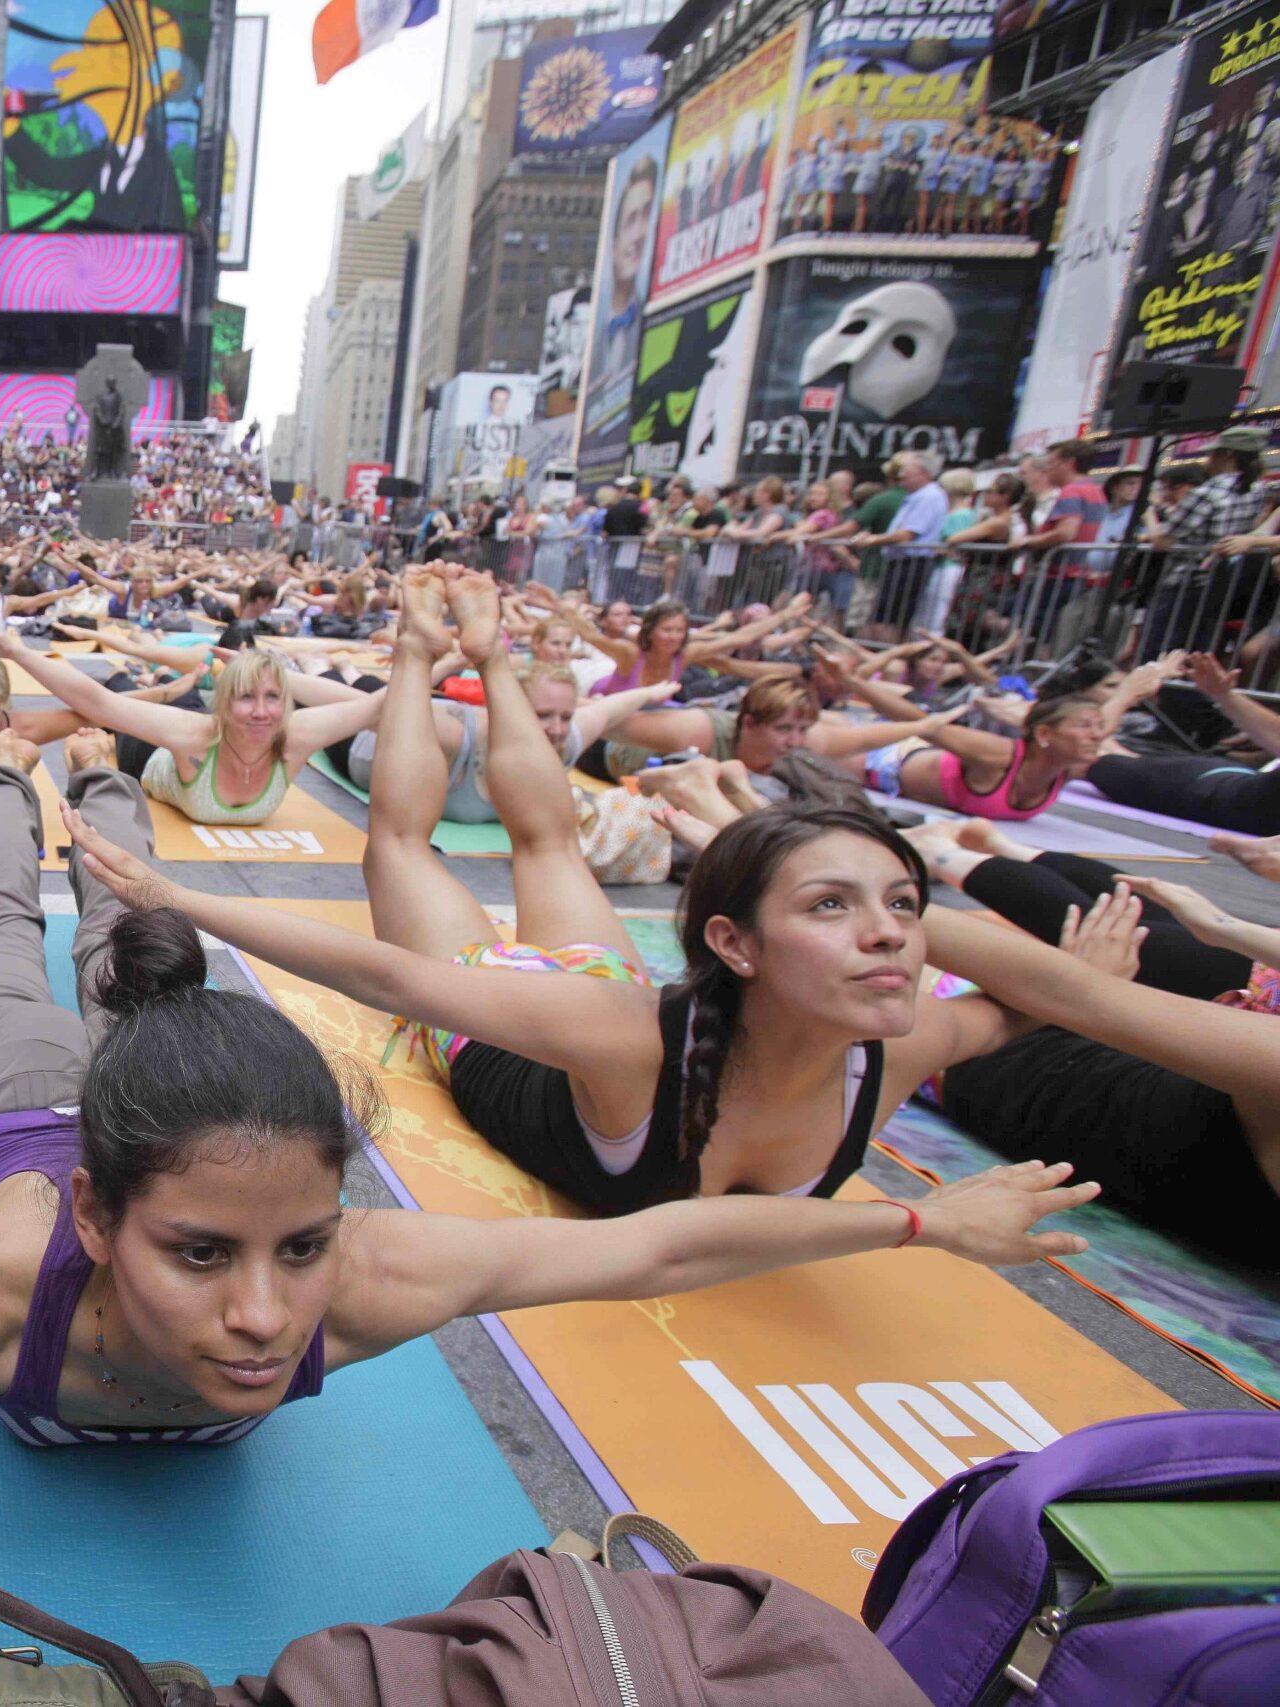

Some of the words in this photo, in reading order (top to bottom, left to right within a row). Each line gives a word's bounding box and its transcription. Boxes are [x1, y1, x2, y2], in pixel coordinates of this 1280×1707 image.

[798, 58, 963, 116] CATCH
[811, 258, 868, 282] Tonight
[871, 260, 932, 282] belongs
[1177, 250, 1234, 284] The
[1139, 274, 1264, 320] Addams
[1143, 308, 1245, 350] Family
[742, 419, 984, 463] PHANTOM
[191, 825, 325, 855] lucy
